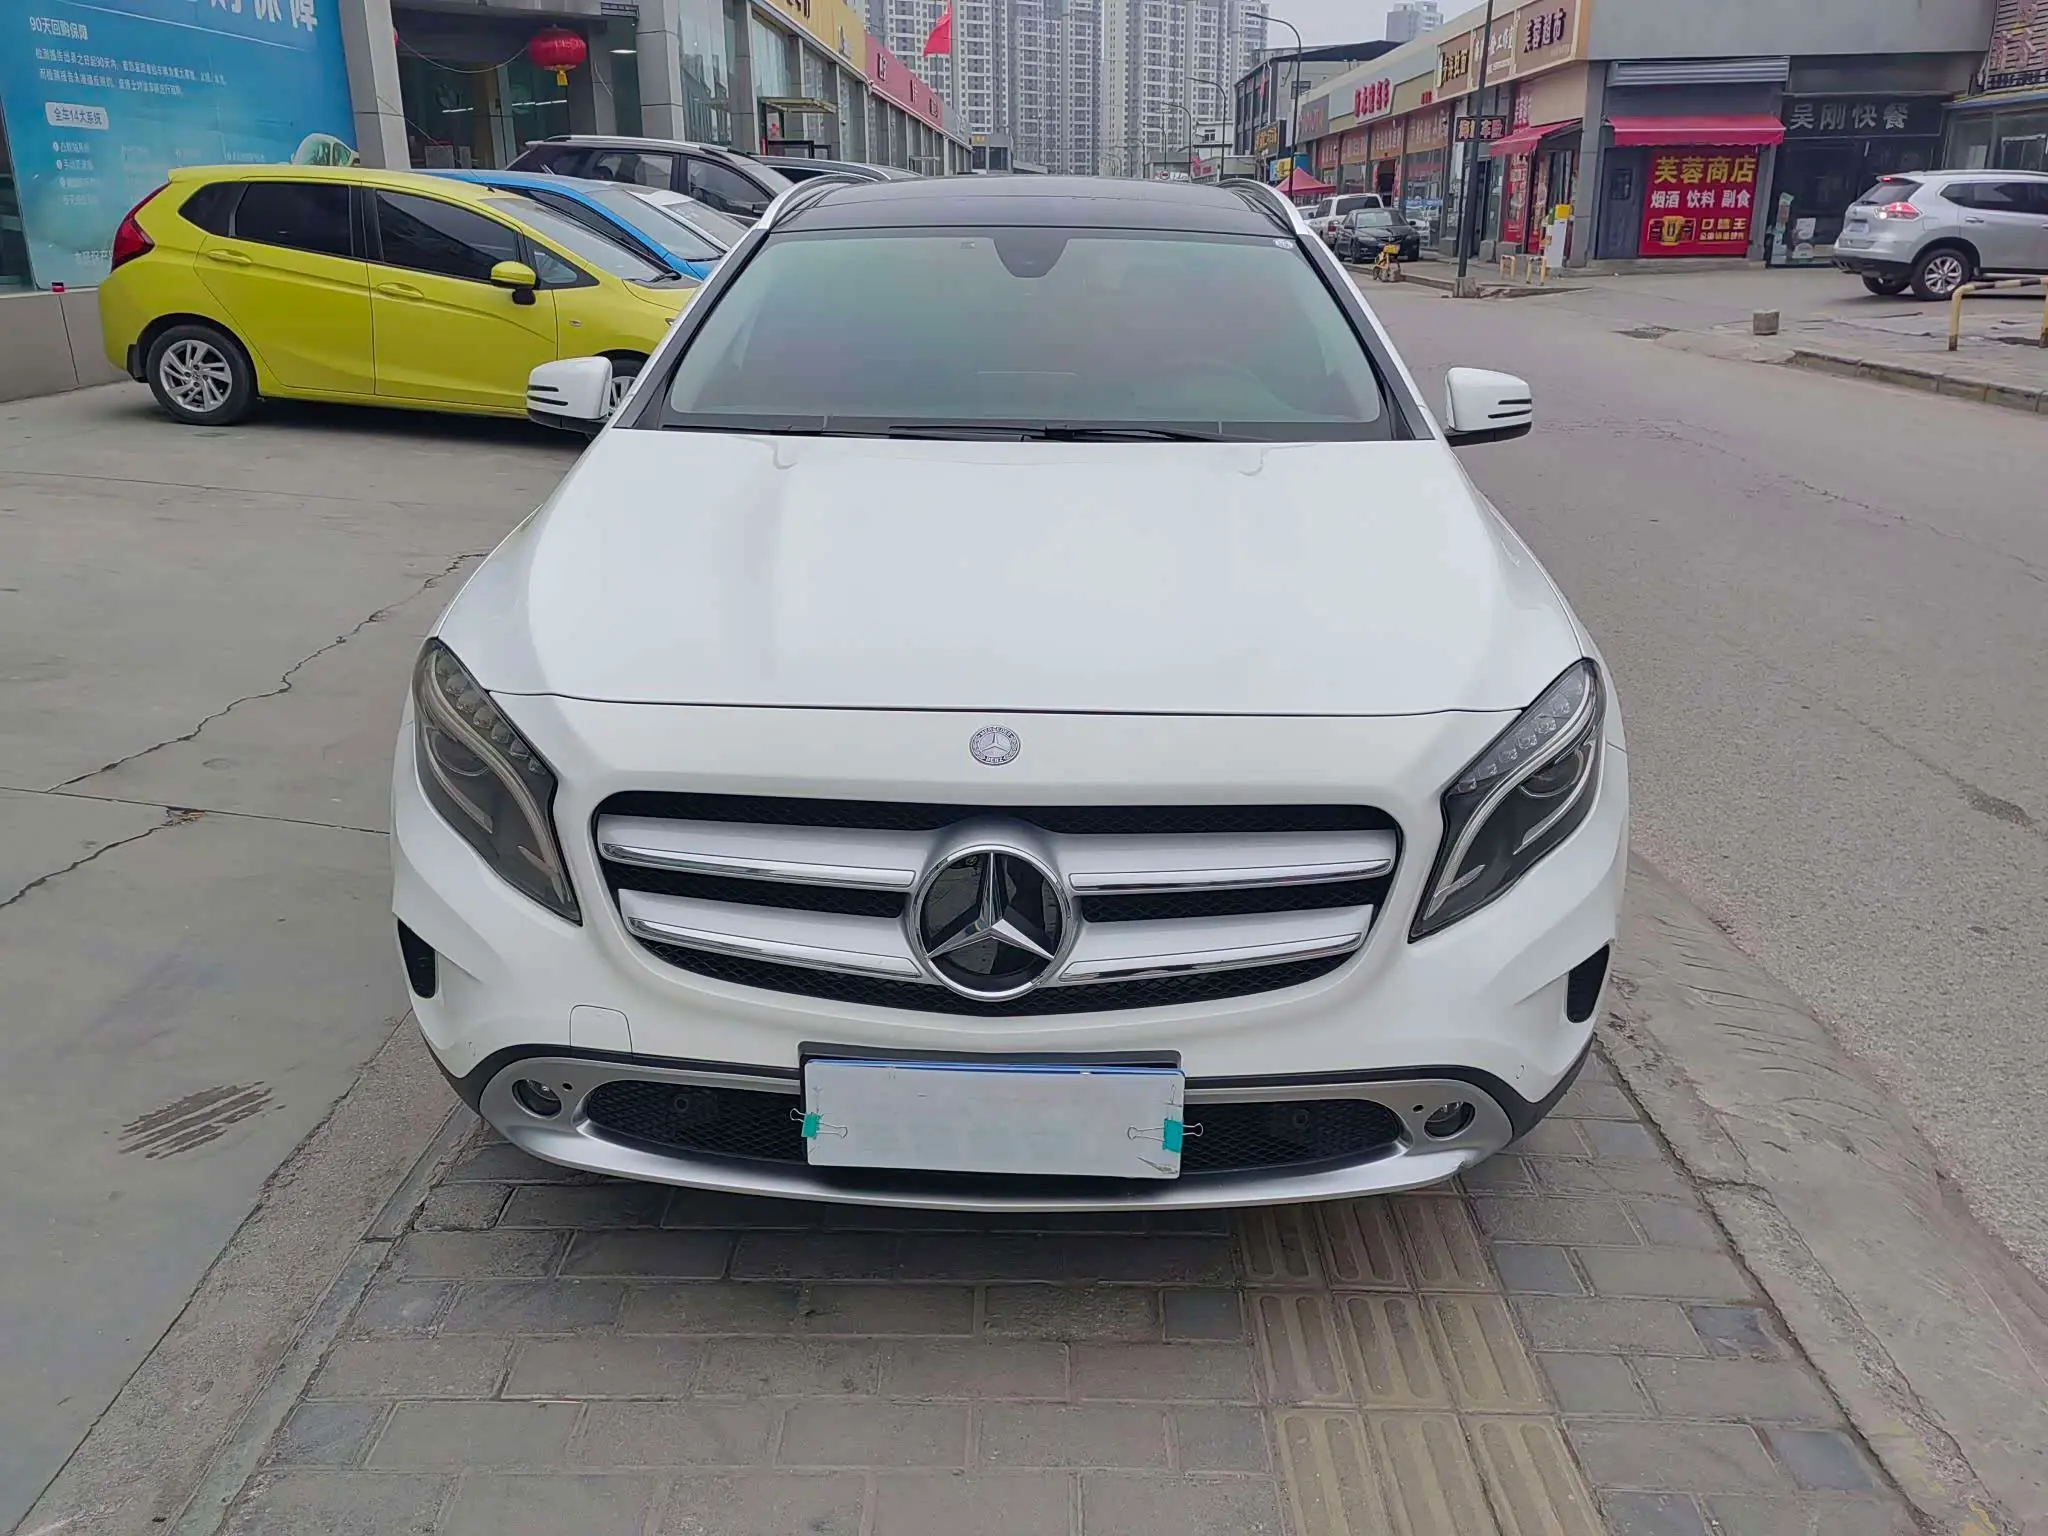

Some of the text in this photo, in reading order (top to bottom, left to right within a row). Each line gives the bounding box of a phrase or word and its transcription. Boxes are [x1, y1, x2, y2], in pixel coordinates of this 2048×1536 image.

[29, 16, 89, 41] 90天回购保障
[54, 106, 103, 124] 全车14大系统
[1790, 103, 1909, 130] 吴刚快餐
[1654, 156, 1757, 184] 芙蓉商店
[1650, 189, 1751, 208] 烟酒 饮料 副食
